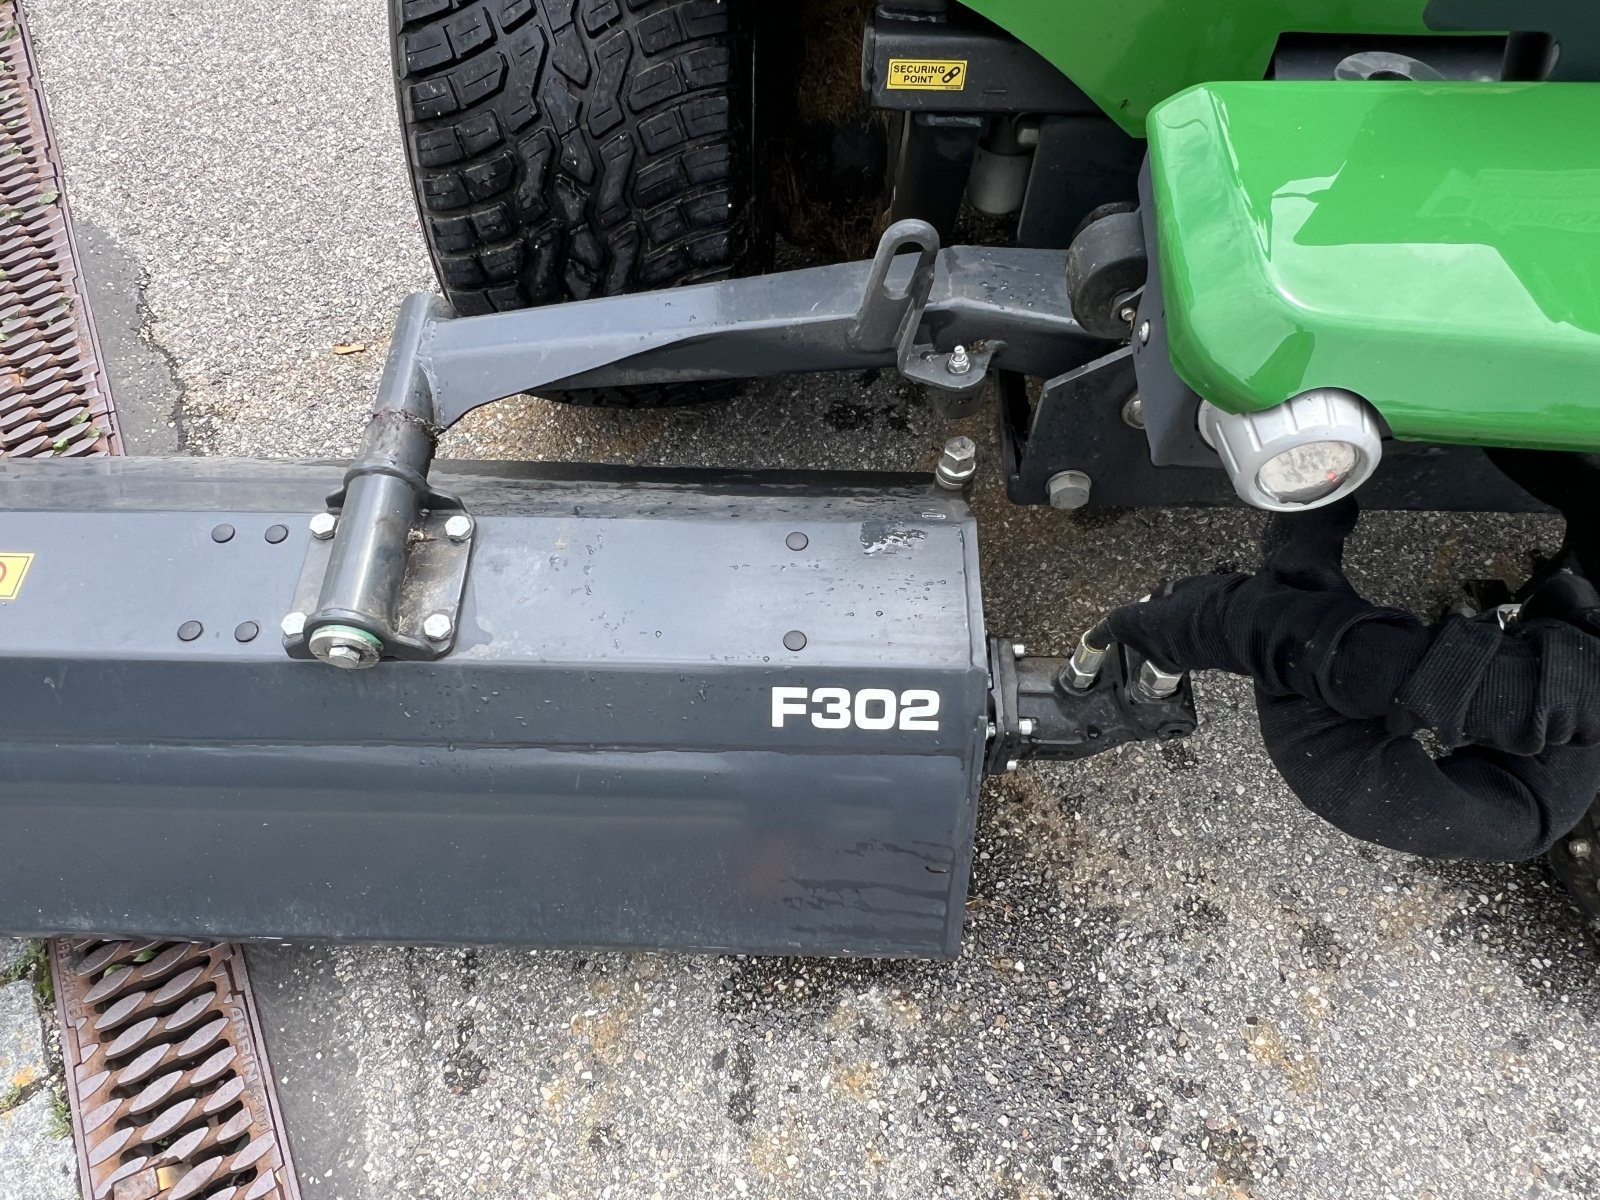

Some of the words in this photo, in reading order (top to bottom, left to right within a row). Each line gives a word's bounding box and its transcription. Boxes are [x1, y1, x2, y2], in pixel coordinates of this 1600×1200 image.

[893, 65, 946, 74] SECURING
[903, 75, 934, 84] POINT
[771, 686, 940, 731] F302
